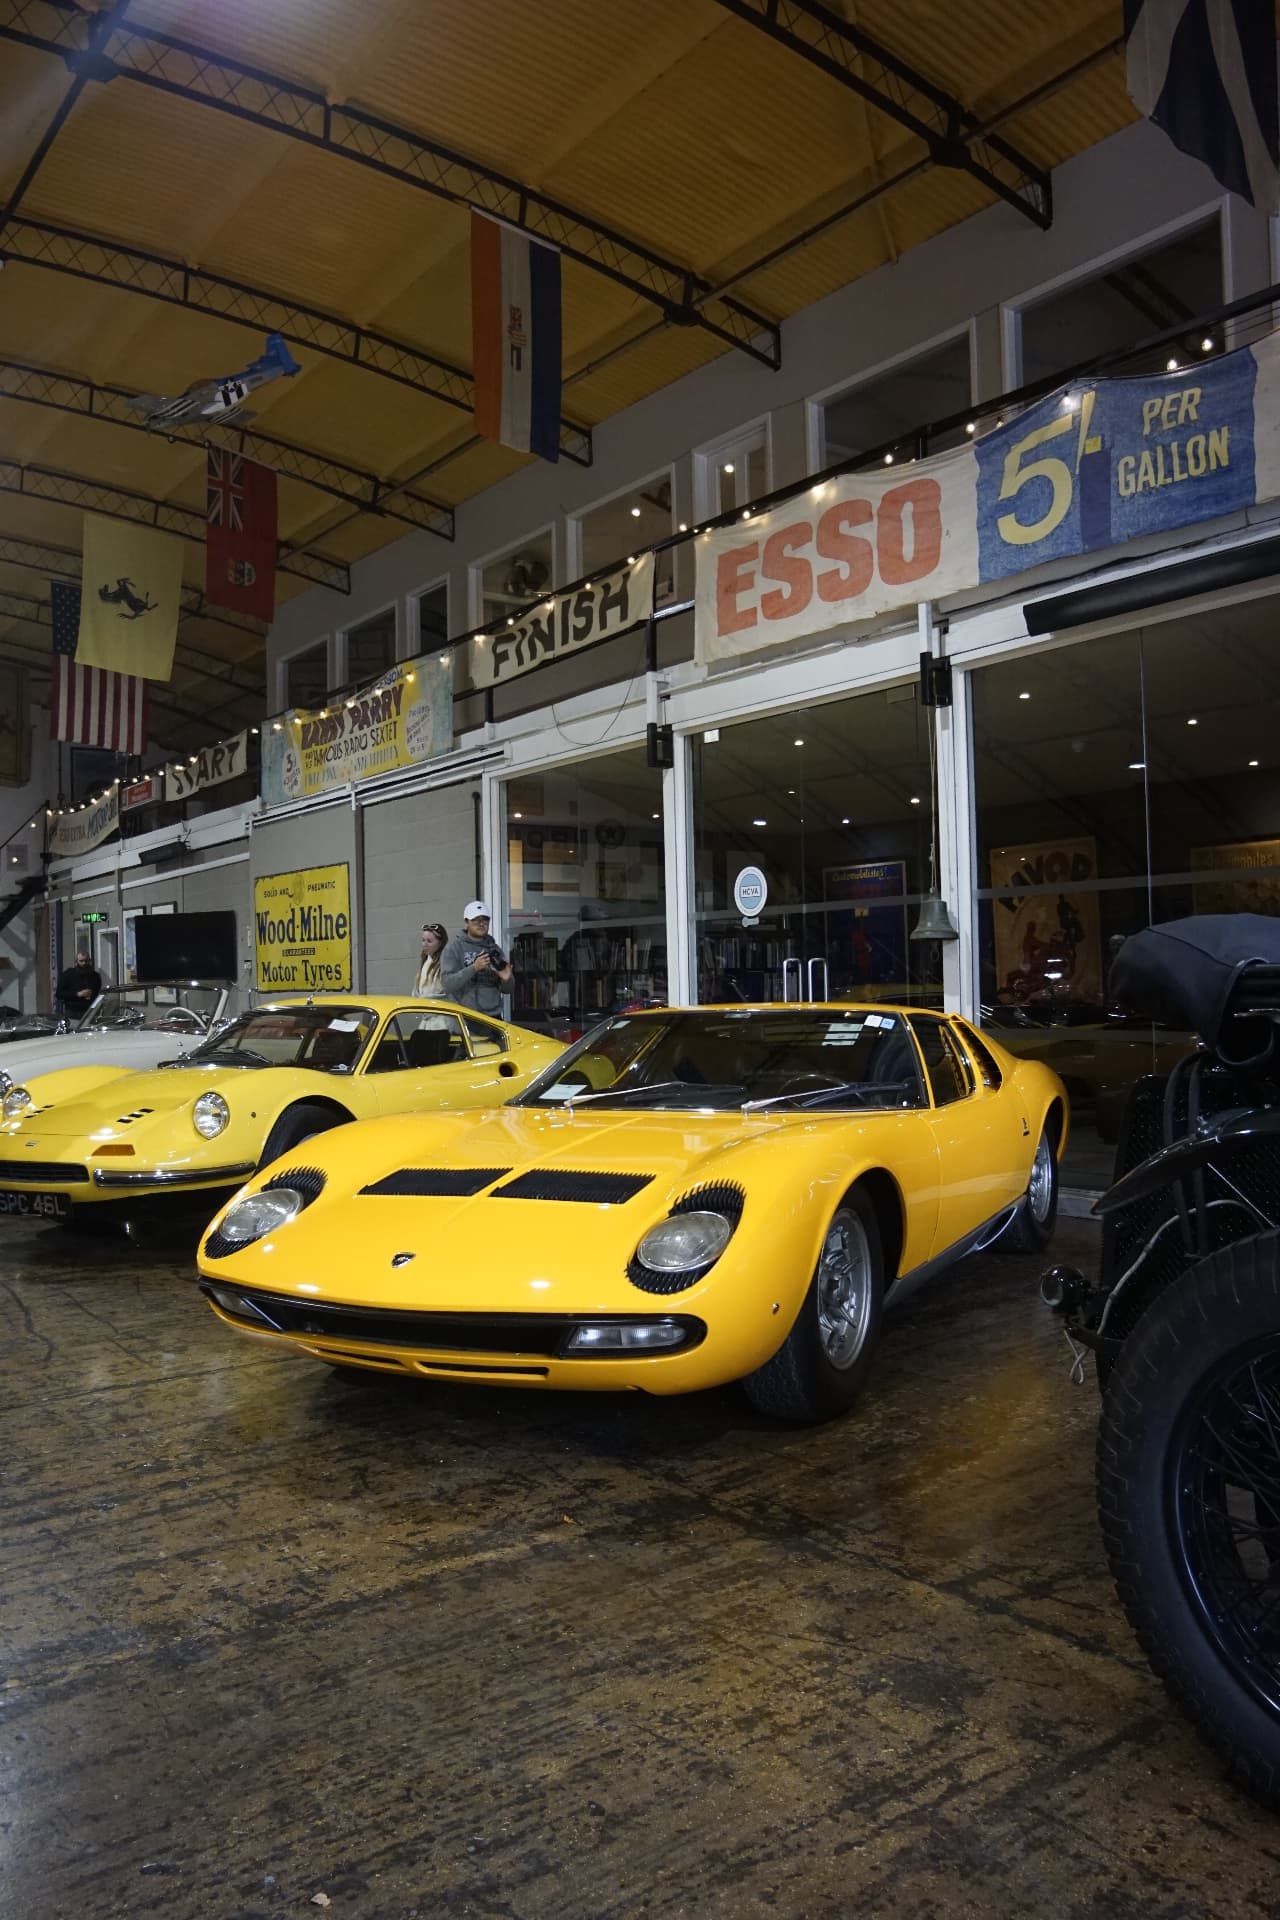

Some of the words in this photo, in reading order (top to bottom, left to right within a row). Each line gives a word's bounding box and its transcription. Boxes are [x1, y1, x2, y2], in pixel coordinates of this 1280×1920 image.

[1142, 387, 1202, 436] PER
[1117, 426, 1230, 497] GALLON
[716, 478, 942, 637] ESSO
[491, 571, 632, 679] FINISH
[348, 684, 405, 734] PARRY
[313, 742, 343, 769] FAMOUS
[344, 733, 368, 761] RADIO
[370, 721, 398, 748] SEXTET
[263, 888, 278, 899] SOLID
[279, 887, 289, 896] AND
[307, 880, 336, 892] PNEUMATIC
[742, 888, 759, 896] HCVA
[261, 961, 298, 983] Motor
[301, 960, 342, 987] Tyres
[33, 1195, 67, 1215] 46L
